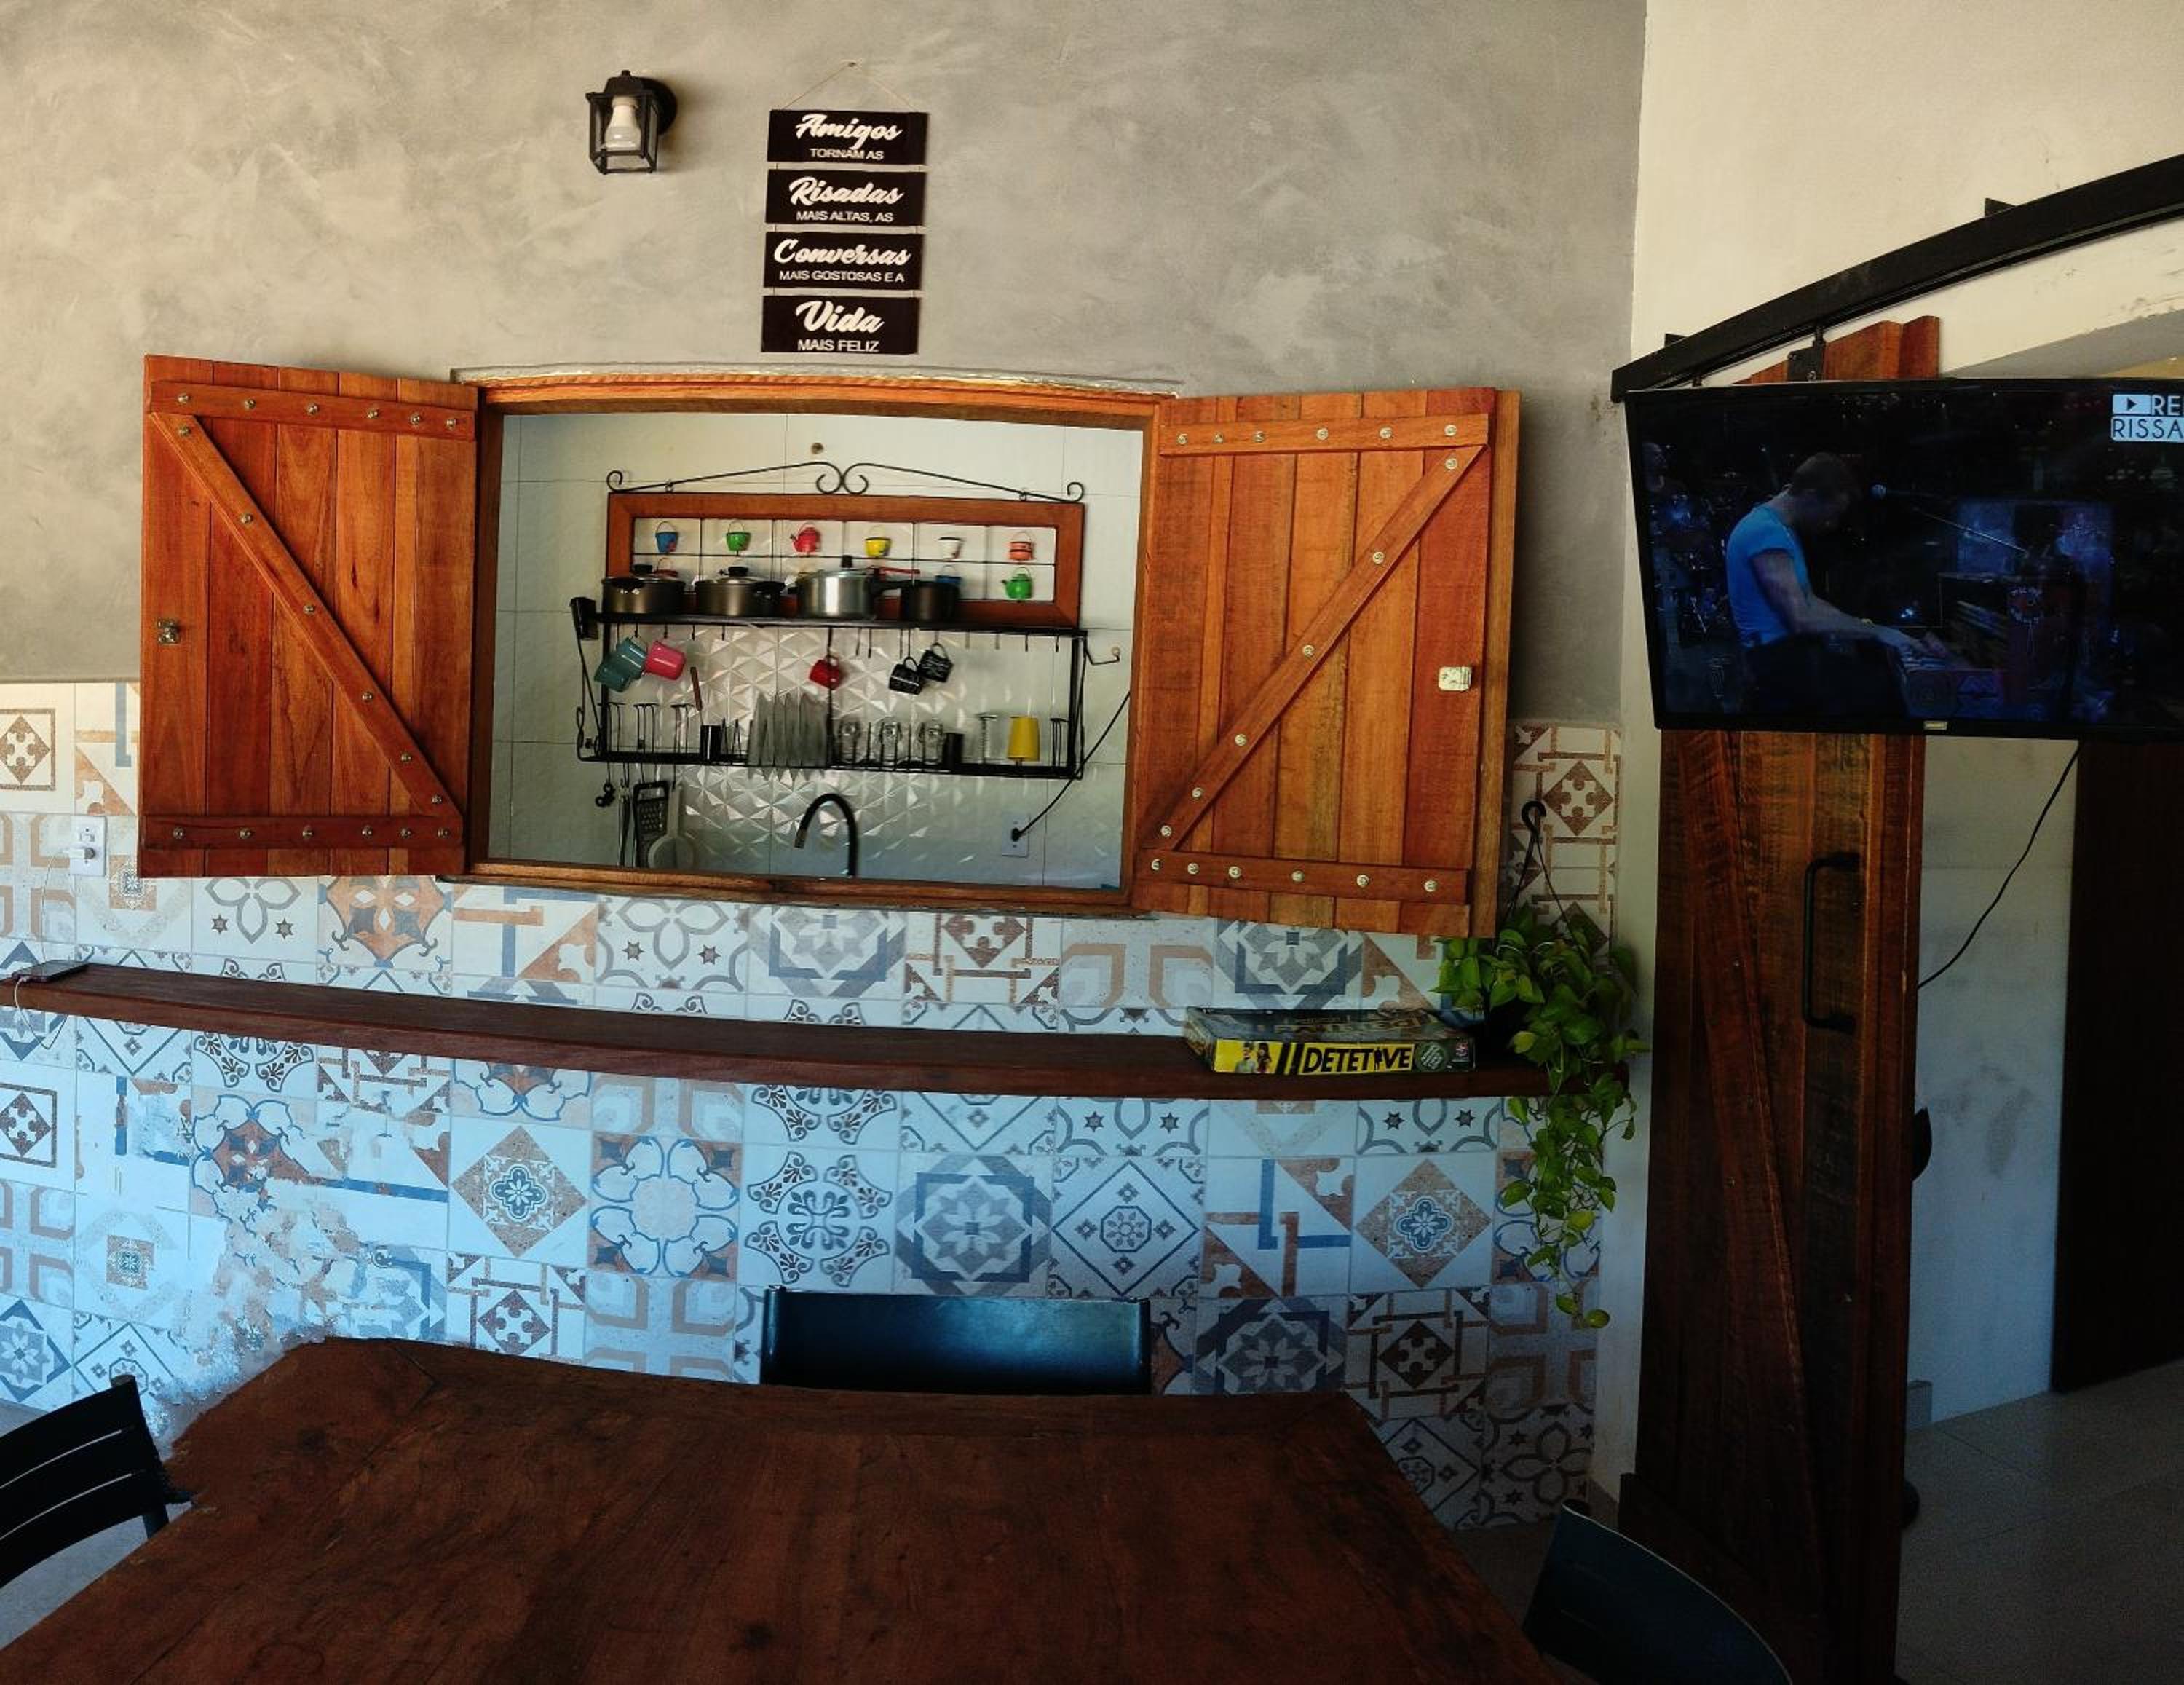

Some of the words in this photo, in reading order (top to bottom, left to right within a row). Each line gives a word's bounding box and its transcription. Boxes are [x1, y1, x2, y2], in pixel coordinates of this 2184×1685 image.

[795, 114, 903, 150] Amigos
[810, 148, 865, 159] TORNAM
[866, 151, 885, 160] AS
[788, 176, 904, 206] Risadas
[796, 210, 828, 221] MAIS
[830, 212, 874, 223] ALTAS,
[877, 213, 894, 222] AS
[774, 239, 911, 265] Conversas
[779, 270, 810, 280] MAIS
[812, 271, 882, 282] GOSTOSAS
[885, 272, 894, 282] E
[895, 272, 905, 282] A
[796, 301, 885, 333] Vida
[797, 339, 834, 351] MAIS
[838, 341, 879, 352] FELIZ
[1303, 1047, 1412, 1073] DETETIVE
